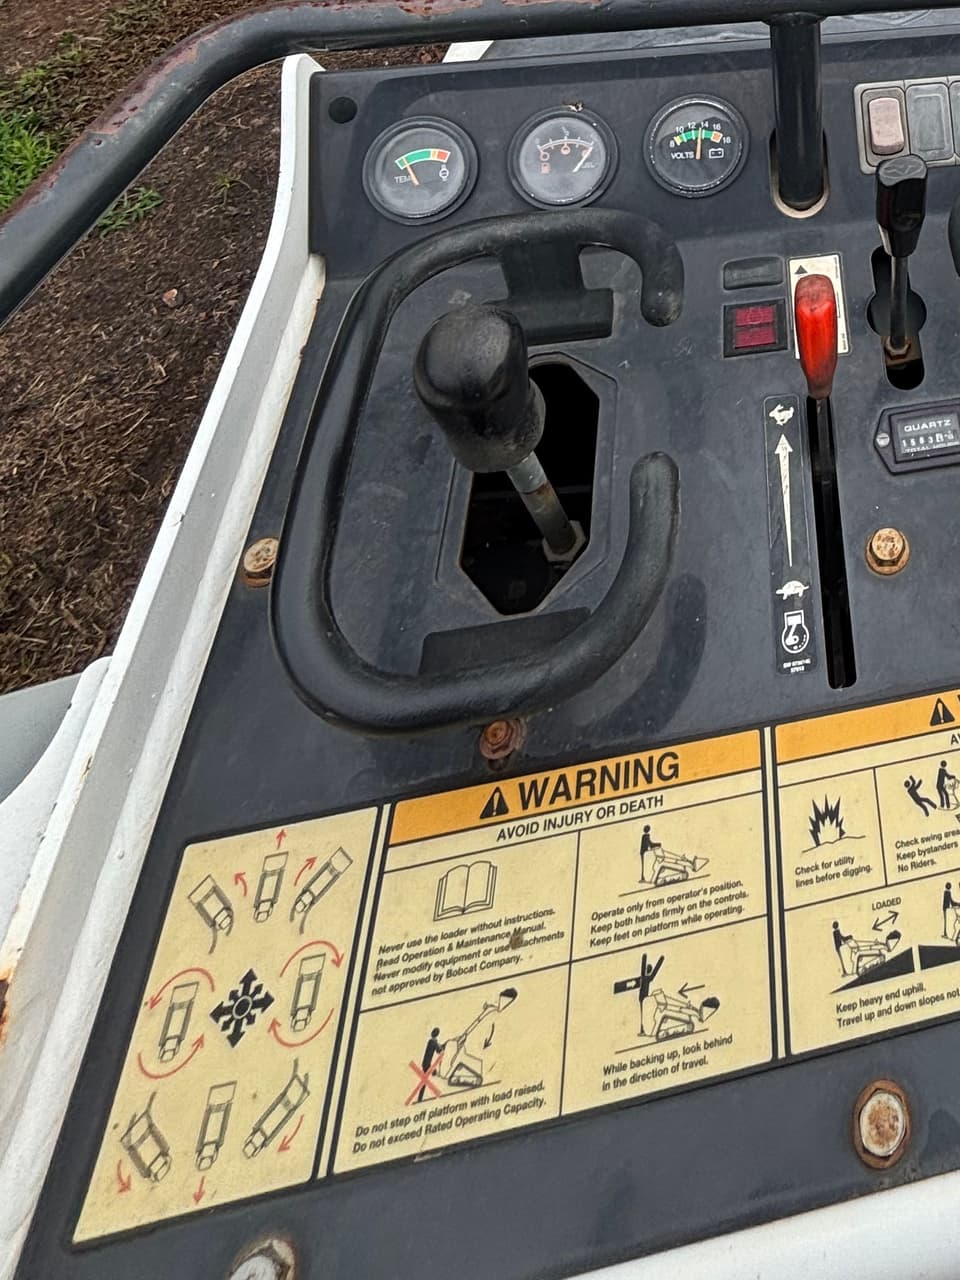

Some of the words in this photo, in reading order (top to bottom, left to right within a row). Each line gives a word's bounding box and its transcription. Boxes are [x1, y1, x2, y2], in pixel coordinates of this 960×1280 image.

[671, 151, 694, 160] VOLTS
[904, 419, 951, 432] QUARTZ
[518, 751, 679, 811] WARNING
[496, 821, 540, 842] AVOID
[543, 809, 593, 831] INJURY
[596, 805, 615, 820] OR
[619, 794, 663, 815] DEATH
[894, 837, 920, 850] Check
[920, 833, 943, 844] swing
[944, 829, 960, 838] area
[896, 851, 916, 861] Keep
[917, 841, 959, 857] bystanders
[795, 863, 820, 876] Check
[821, 861, 832, 870] for
[834, 856, 855, 867] utility
[795, 878, 814, 888] lines
[815, 872, 841, 884] before
[842, 864, 872, 877] digging.
[897, 864, 909, 873] No
[910, 858, 937, 871] Riders.
[590, 923, 613, 935] Keep
[614, 917, 633, 929] both
[635, 911, 660, 924] hands
[662, 905, 685, 918] firmly
[686, 903, 697, 912] on
[699, 899, 712, 909] the
[714, 890, 749, 905] controls.
[591, 907, 625, 922] Operate
[626, 902, 644, 913] only
[645, 898, 665, 909] from
[666, 887, 708, 904] operator's
[709, 880, 743, 896] position.
[871, 897, 902, 911] LOADED
[378, 942, 405, 955] Never
[406, 938, 423, 949] use
[424, 935, 439, 944] the
[440, 928, 468, 941] loader
[470, 919, 502, 934] without
[503, 908, 556, 926] instructions.
[590, 936, 612, 948] Keep
[613, 930, 630, 942] feet
[632, 928, 643, 938] on
[644, 920, 679, 937] platform
[681, 913, 702, 926] while
[704, 905, 744, 921] operating.
[401, 946, 445, 963] Operation
[447, 942, 453, 952] &
[455, 931, 511, 950] Maintenance
[371, 984, 387, 996] not
[388, 973, 432, 993] approved
[432, 972, 444, 983] by
[445, 963, 477, 979] Bobcat
[479, 955, 523, 971] Company.
[836, 1002, 858, 1014] Keep
[859, 995, 883, 1008] heavy
[885, 988, 900, 1001] end
[902, 982, 926, 997] uphill.
[836, 1012, 863, 1028] Travel
[864, 1011, 875, 1022] up
[877, 1004, 893, 1018] and
[894, 1001, 917, 1013] down
[918, 993, 945, 1007] slopes
[946, 988, 960, 999] not
[602, 1081, 611, 1092] in
[613, 1077, 628, 1089] the
[629, 1067, 669, 1085] direction
[670, 1062, 680, 1074] of
[682, 1055, 708, 1071] travel.
[603, 1062, 628, 1076] While
[630, 1053, 665, 1069] backing
[667, 1050, 681, 1061] up,
[682, 1042, 701, 1056] look
[703, 1033, 733, 1050] behind
[352, 1142, 367, 1154] Do
[369, 1136, 386, 1150] not
[387, 1126, 423, 1145] exceed
[424, 1118, 453, 1135] Rated
[455, 1108, 501, 1128] Operating
[503, 1097, 547, 1115] Capacity.
[355, 1126, 370, 1138] Do
[371, 1120, 388, 1134] not
[390, 1116, 412, 1129] step
[413, 1109, 427, 1123] off
[427, 1102, 468, 1122] platform
[470, 1095, 490, 1109] with
[492, 1088, 513, 1103] load
[514, 1080, 545, 1098] raised.
